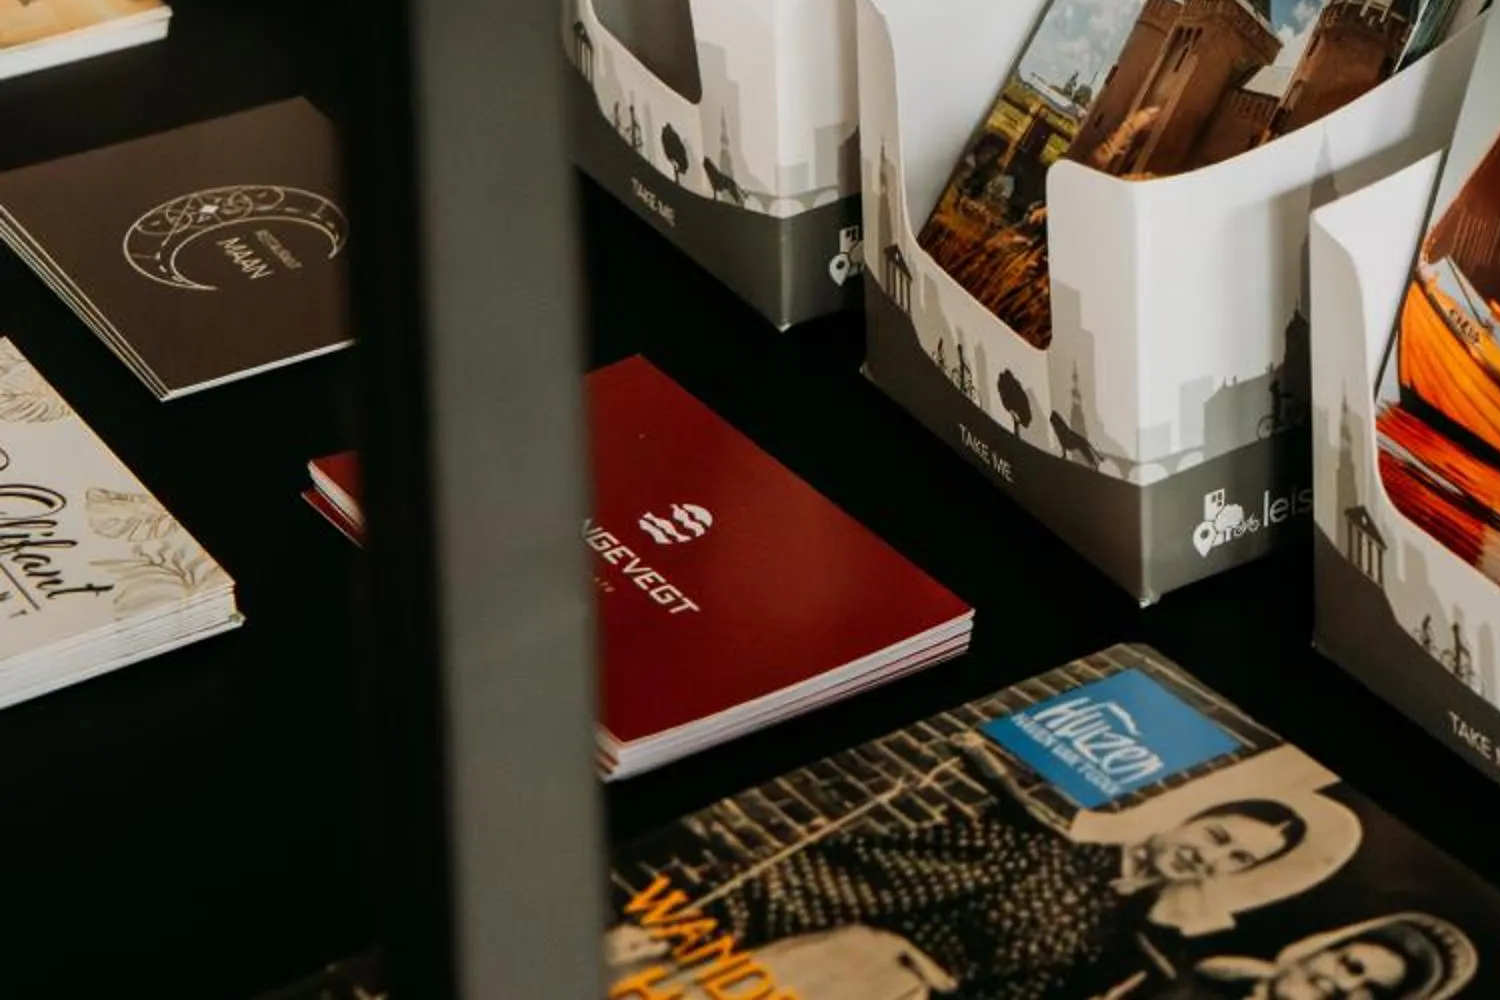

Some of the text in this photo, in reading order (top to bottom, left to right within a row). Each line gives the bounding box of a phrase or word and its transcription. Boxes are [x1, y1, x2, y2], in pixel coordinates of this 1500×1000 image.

[957, 423, 1015, 483] TAKE ME
[581, 518, 701, 614] NGEVEGT
[1448, 711, 1492, 760] TAKE
[623, 872, 798, 1000] WAND
